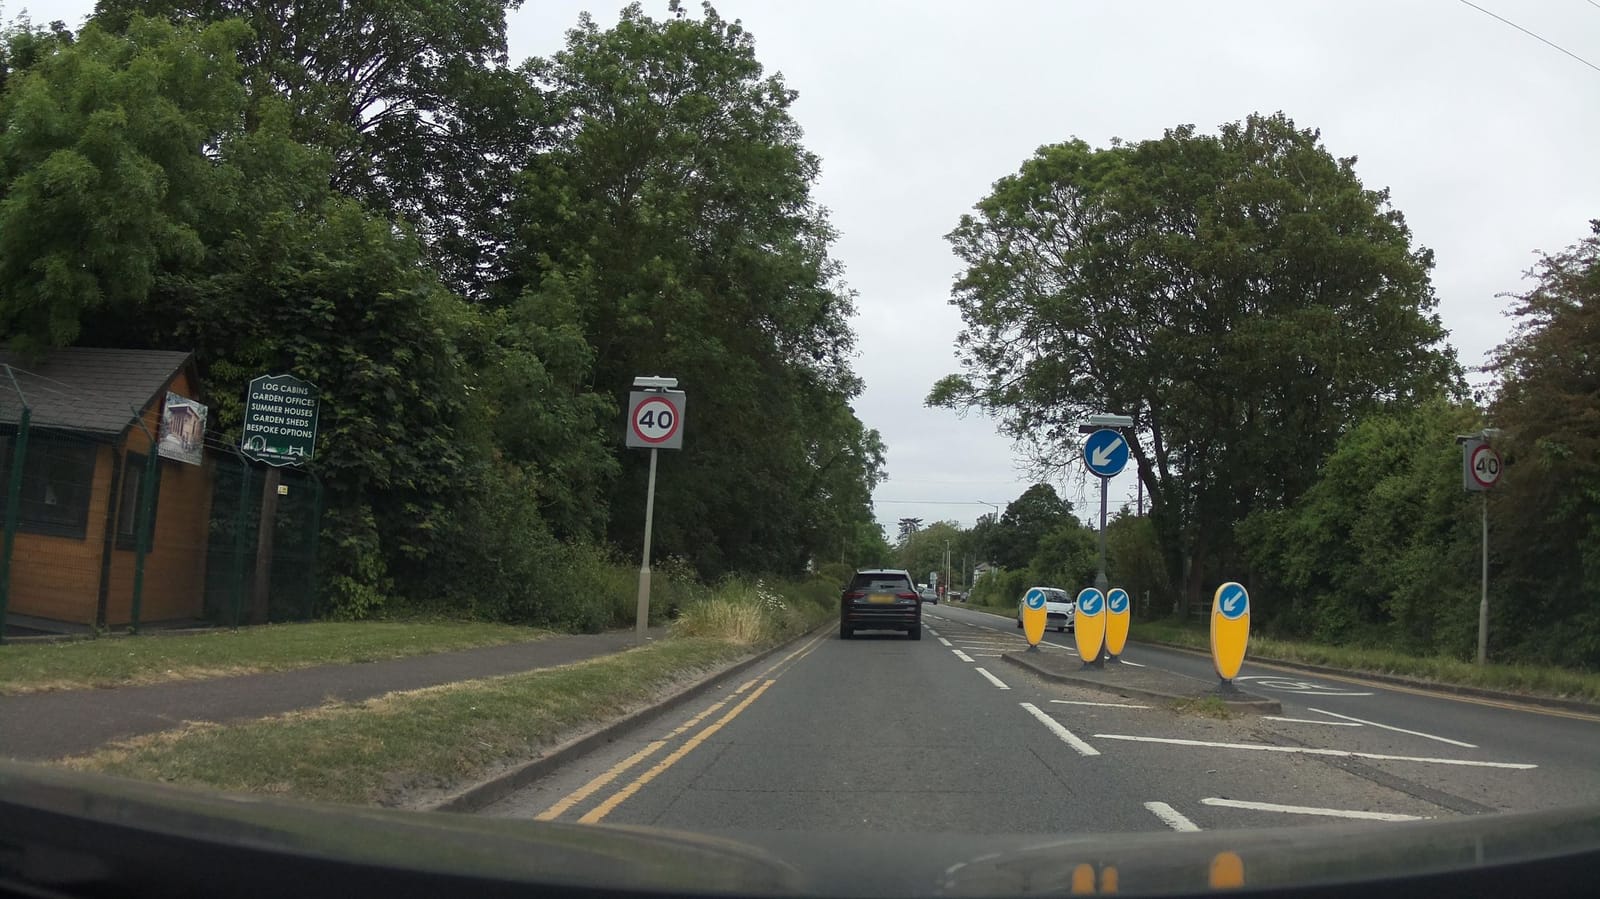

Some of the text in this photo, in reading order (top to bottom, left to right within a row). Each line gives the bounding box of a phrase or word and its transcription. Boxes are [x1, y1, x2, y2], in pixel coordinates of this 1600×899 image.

[262, 383, 308, 395] LOG CABINS
[252, 392, 315, 407] GARDEN OFFICES
[251, 403, 313, 417] SUMMER HOUSES
[253, 414, 309, 427] GARDEN SHEDS
[639, 410, 673, 429] 40
[246, 424, 313, 438] BESPOKE OPTIONS
[1476, 458, 1498, 474] 40
